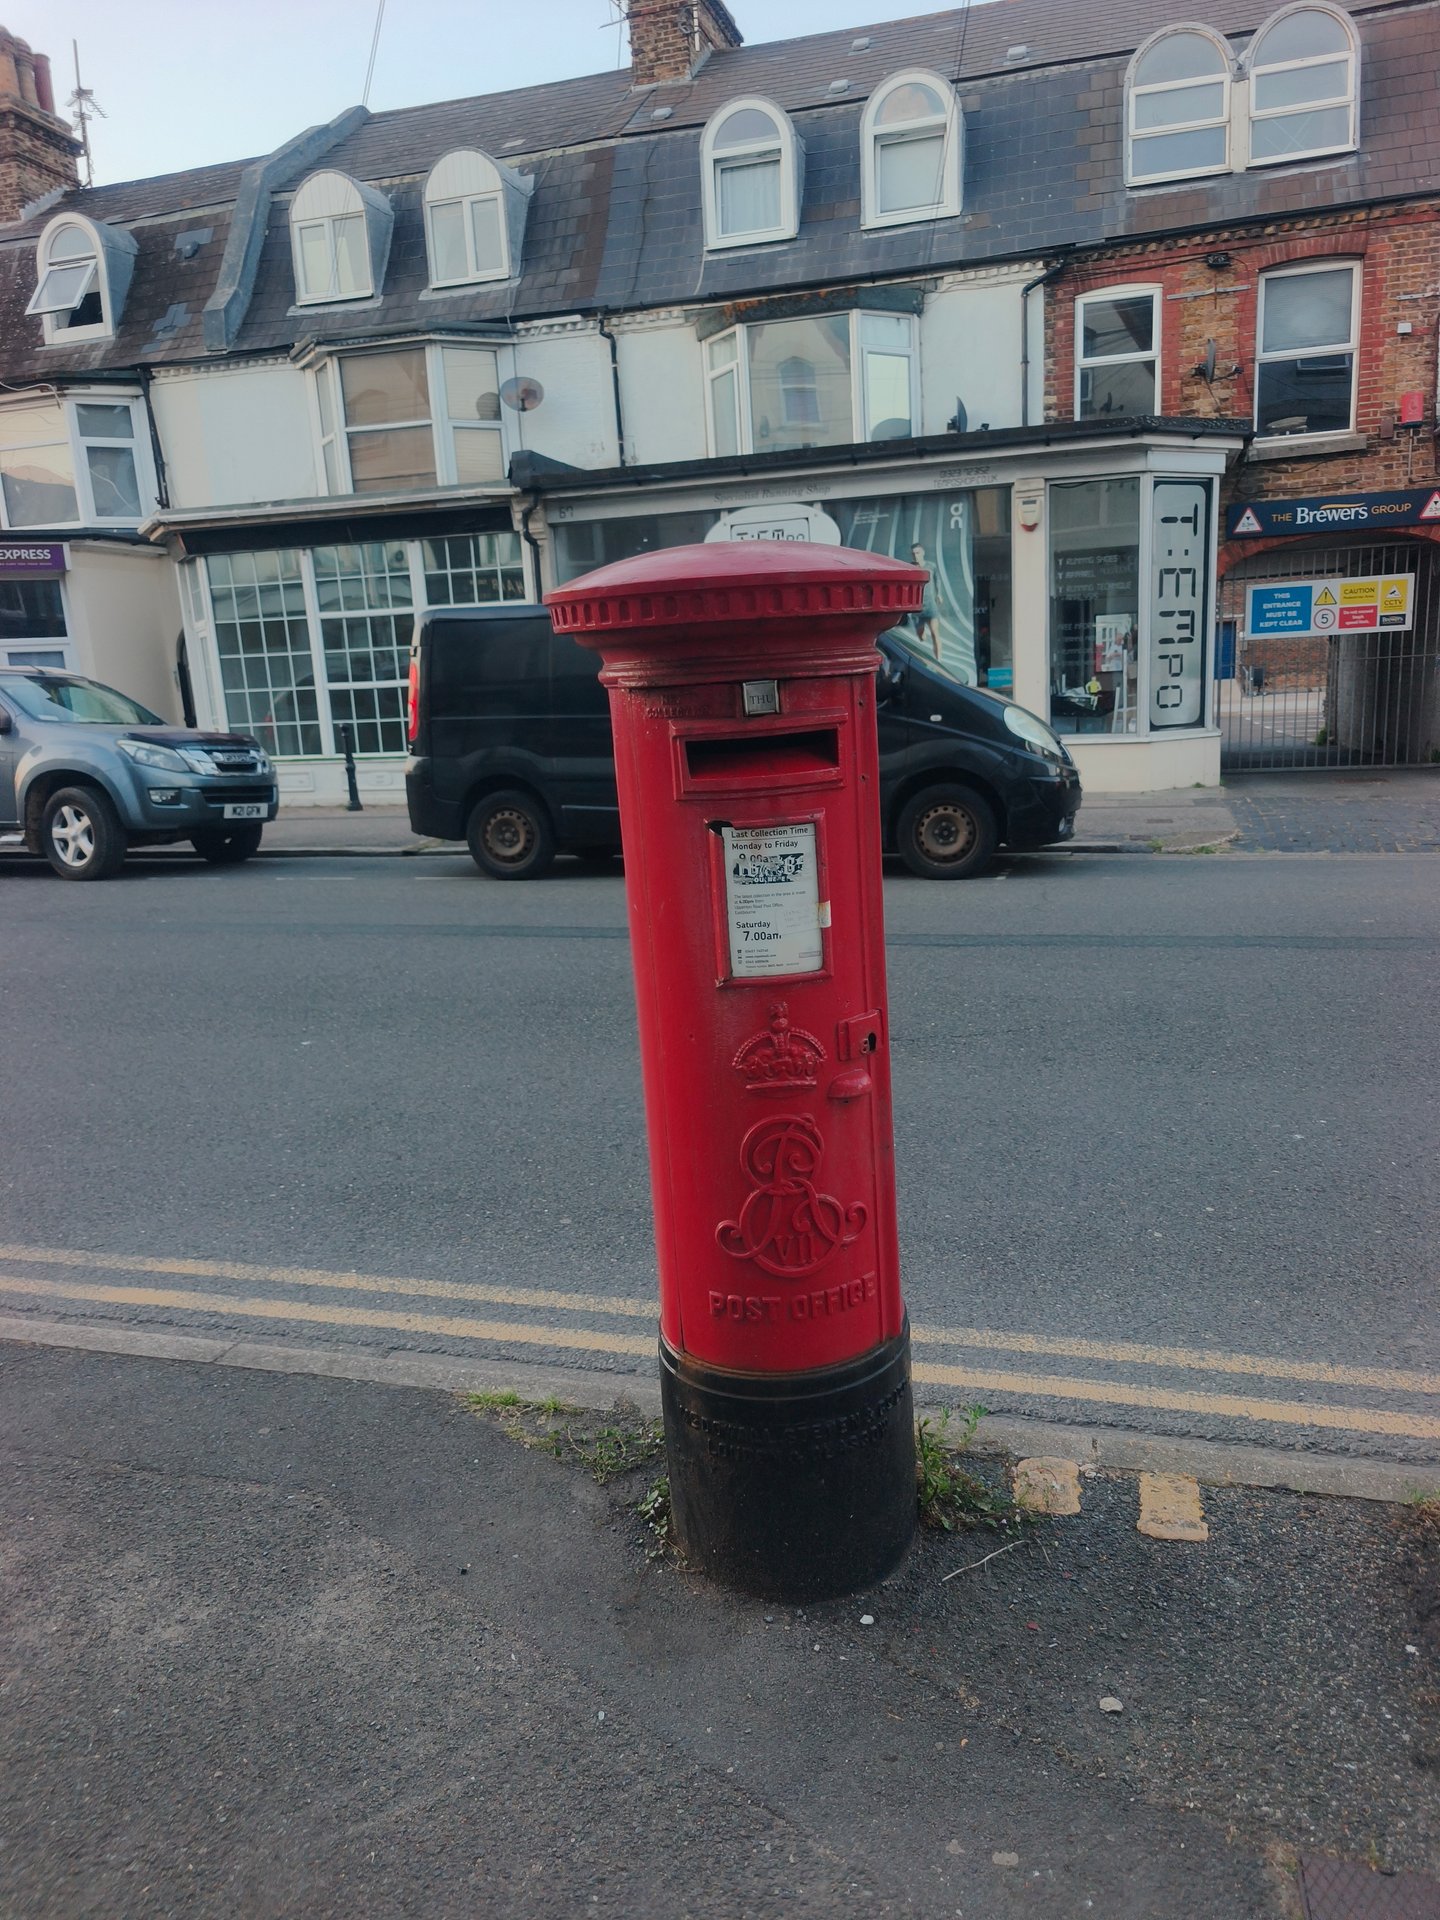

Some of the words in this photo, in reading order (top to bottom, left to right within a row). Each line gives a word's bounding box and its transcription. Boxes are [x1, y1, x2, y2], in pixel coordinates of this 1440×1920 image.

[762, 487, 804, 500] Running
[806, 483, 831, 496] Shop
[1271, 512, 1293, 523] THE
[1295, 505, 1369, 525] Brewers
[1371, 503, 1412, 515] GROUP
[1343, 587, 1375, 595] CAUTION
[1263, 601, 1301, 609] ENTRANCE
[1279, 619, 1303, 627] CLEAR
[1321, 614, 1329, 624] 5
[750, 695, 773, 705] THU
[731, 831, 748, 839] Last
[750, 829, 788, 838] Collection
[732, 842, 762, 851] Monday
[775, 840, 799, 848] Friday
[736, 920, 771, 929] Saturday
[742, 930, 782, 941] 7.00am
[708, 1290, 782, 1322] POST
[790, 1271, 877, 1321] OFFICE
